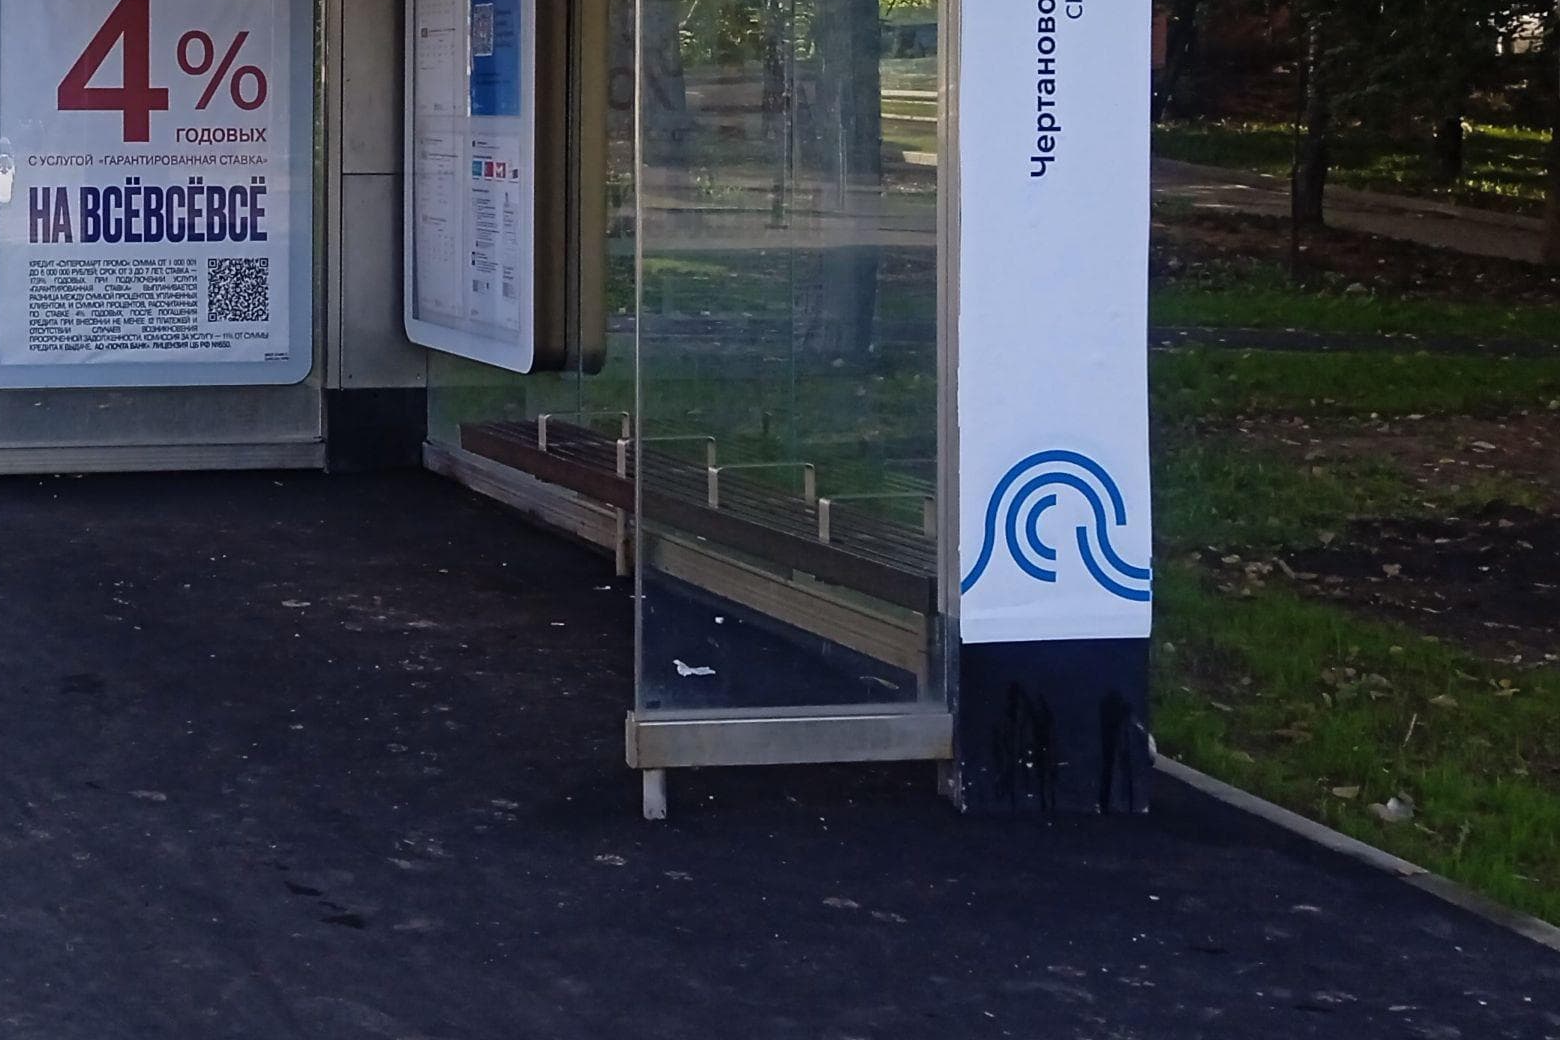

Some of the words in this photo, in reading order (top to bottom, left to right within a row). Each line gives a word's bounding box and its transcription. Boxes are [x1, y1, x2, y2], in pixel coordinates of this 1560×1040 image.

[176, 127, 268, 145] ГОДОВЫХ
[28, 156, 37, 166] С
[39, 153, 94, 166] УСЛУГОЙ
[98, 154, 217, 166] «ГАРАНТИРОВАННАЯ
[218, 154, 269, 166] СТАВКА»
[29, 186, 73, 244] НА
[80, 176, 268, 244] ВСЁВСЁВСЁ
